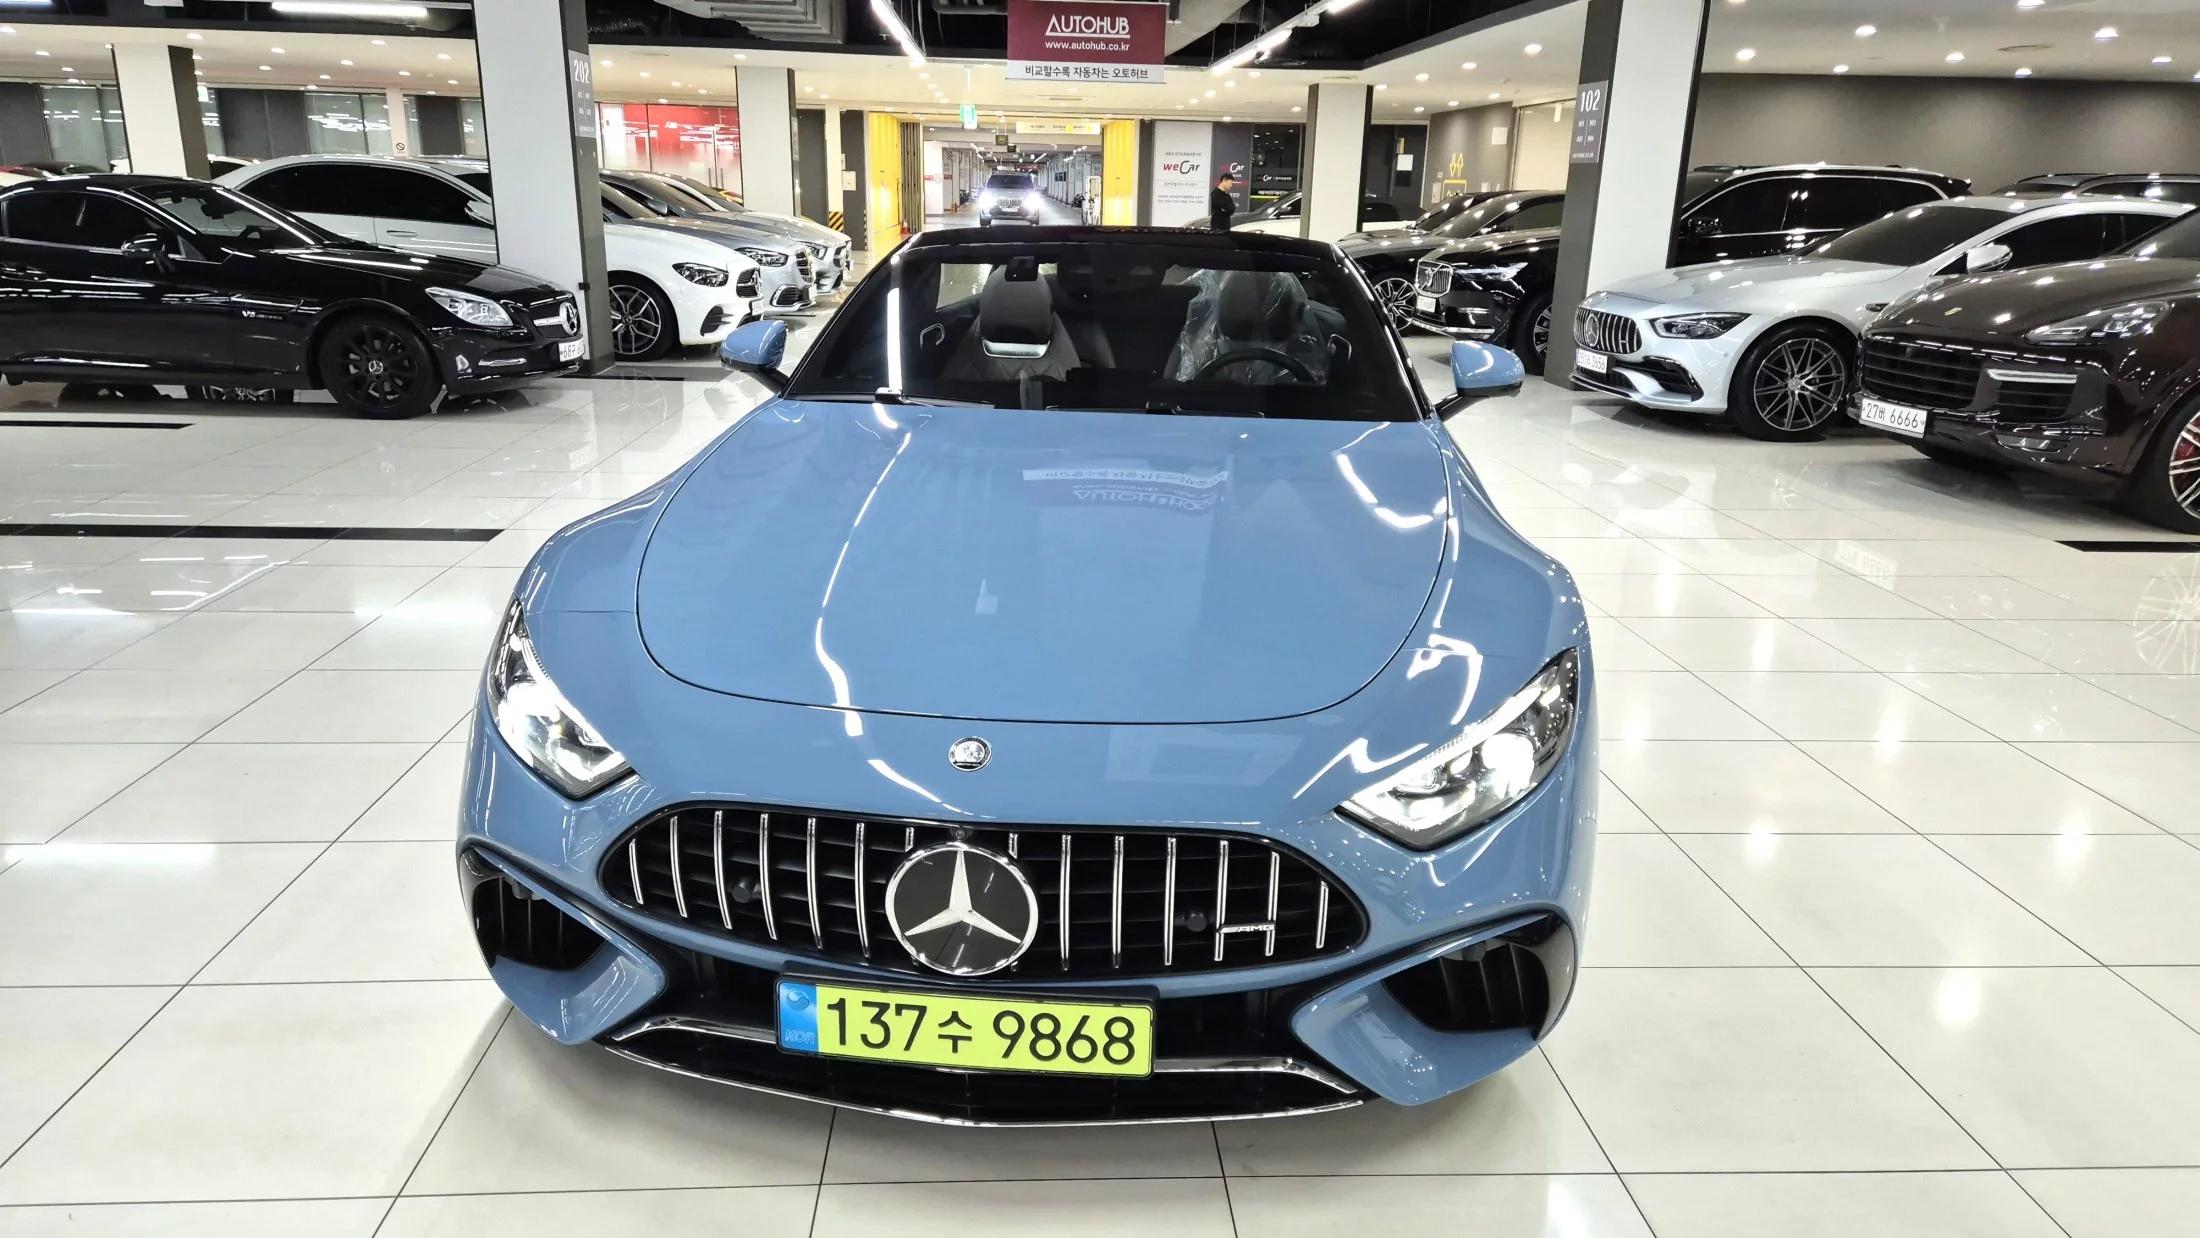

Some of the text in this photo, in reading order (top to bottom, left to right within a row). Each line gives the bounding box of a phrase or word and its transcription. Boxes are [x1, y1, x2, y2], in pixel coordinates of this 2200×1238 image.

[1045, 14, 1130, 35] AUTOHUB
[1045, 41, 1130, 51] www.autohub.co.kr
[573, 59, 590, 84] 202
[1025, 65, 1149, 79] 비교할수록 자동차는 오토허브
[1580, 89, 1600, 112] 102
[1163, 160, 1200, 175] weCar
[1889, 408, 1919, 429] 6666
[1238, 924, 1275, 933] AMG
[826, 997, 1136, 1065] 137수 9868
